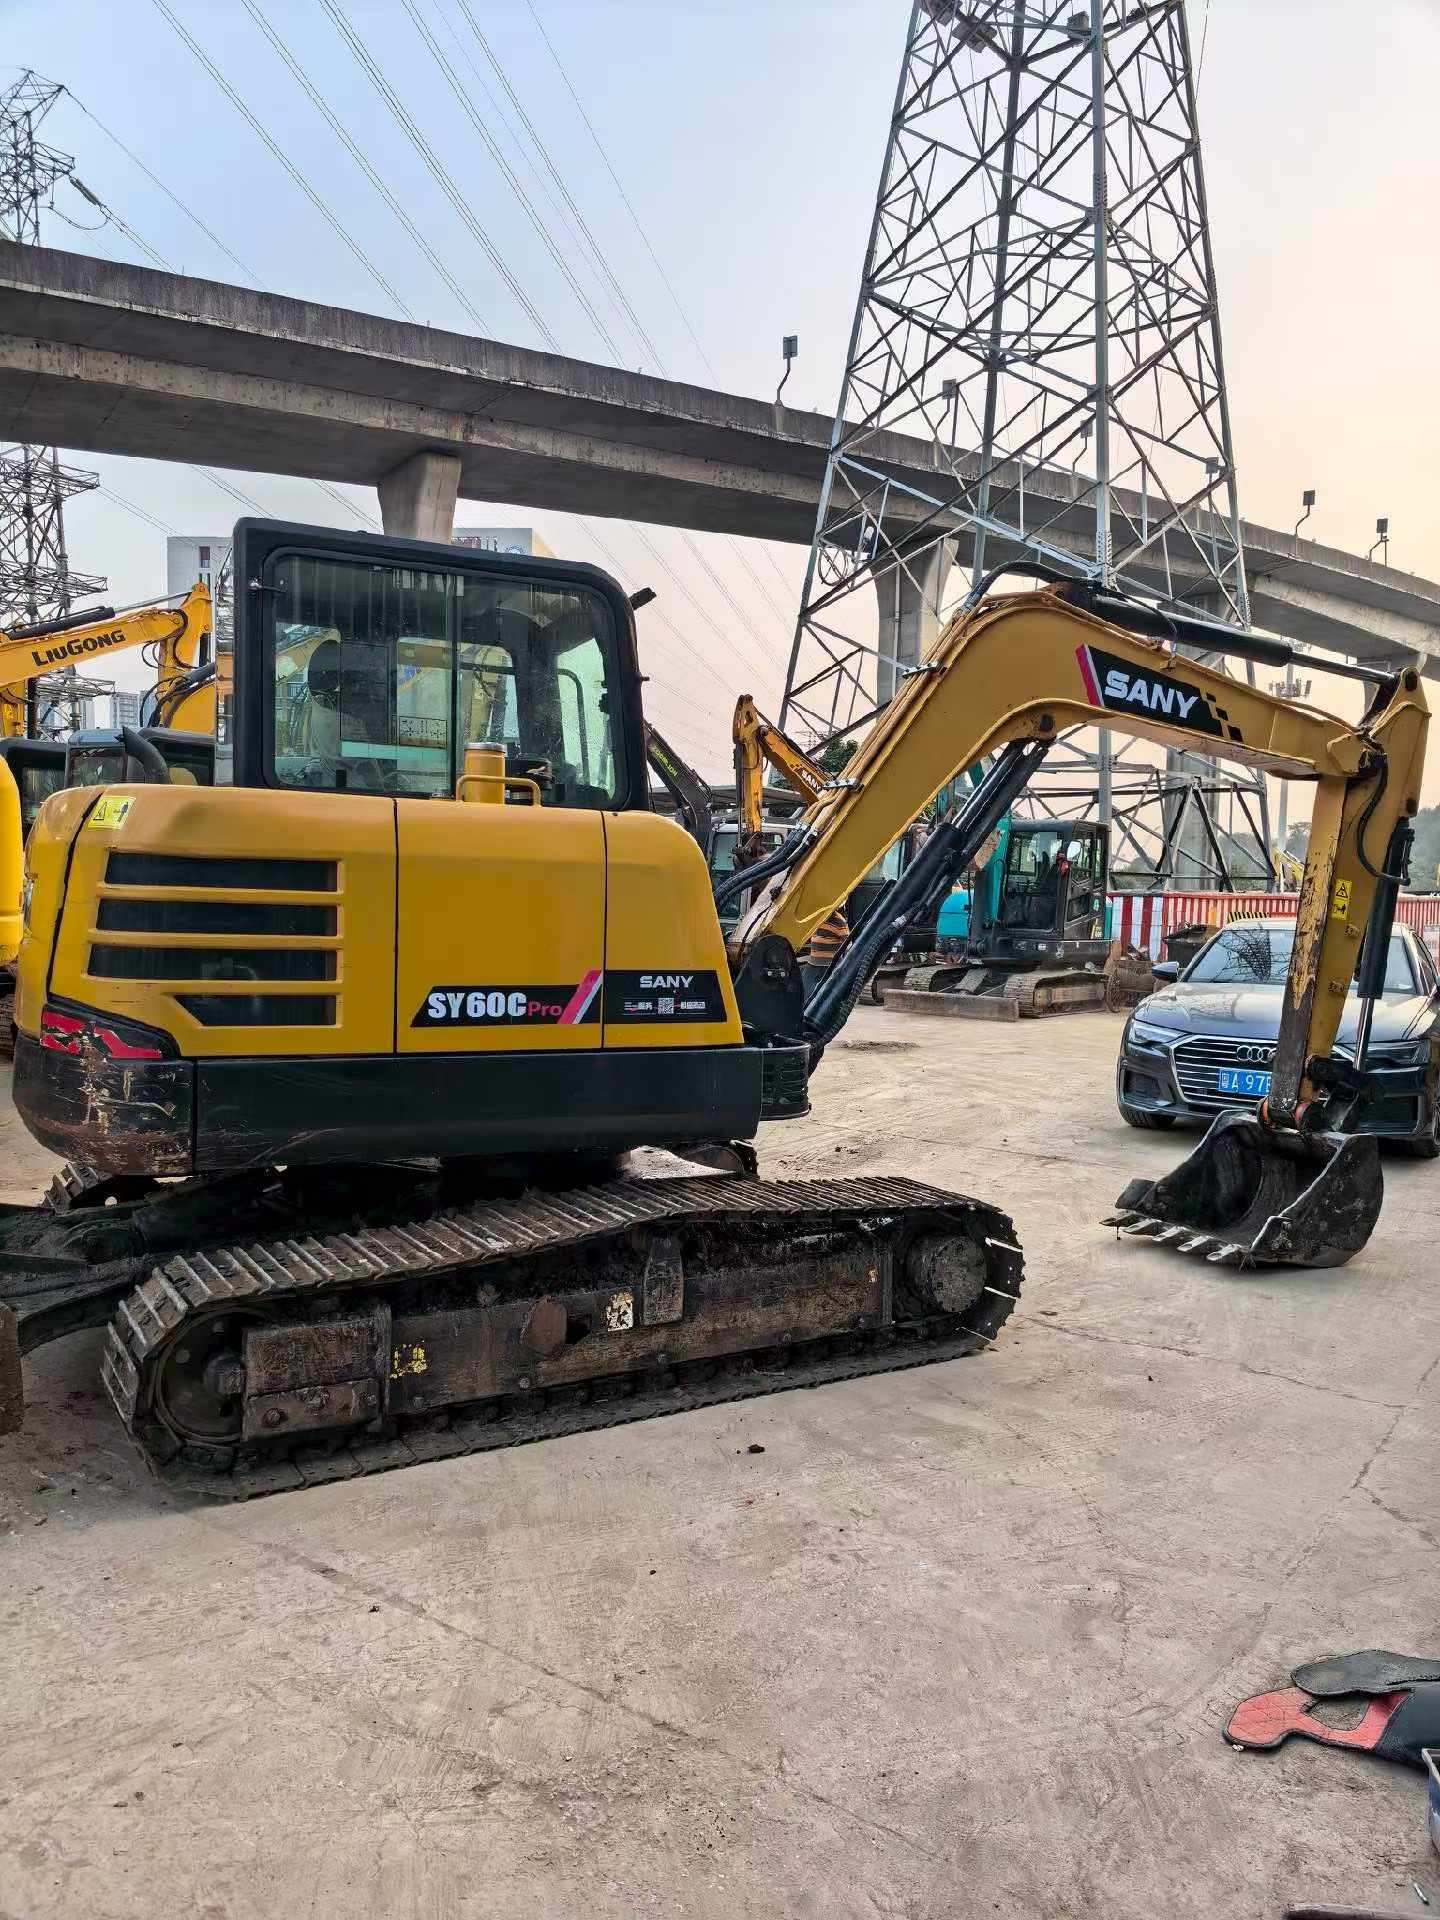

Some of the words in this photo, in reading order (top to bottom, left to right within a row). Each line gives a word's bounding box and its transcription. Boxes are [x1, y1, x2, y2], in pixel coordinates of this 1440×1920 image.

[31, 629, 126, 667] LIUGONG
[1104, 669, 1199, 719] SANY
[640, 975, 694, 988] SANY
[428, 992, 527, 1018] SY60C
[527, 1001, 562, 1017] Pro
